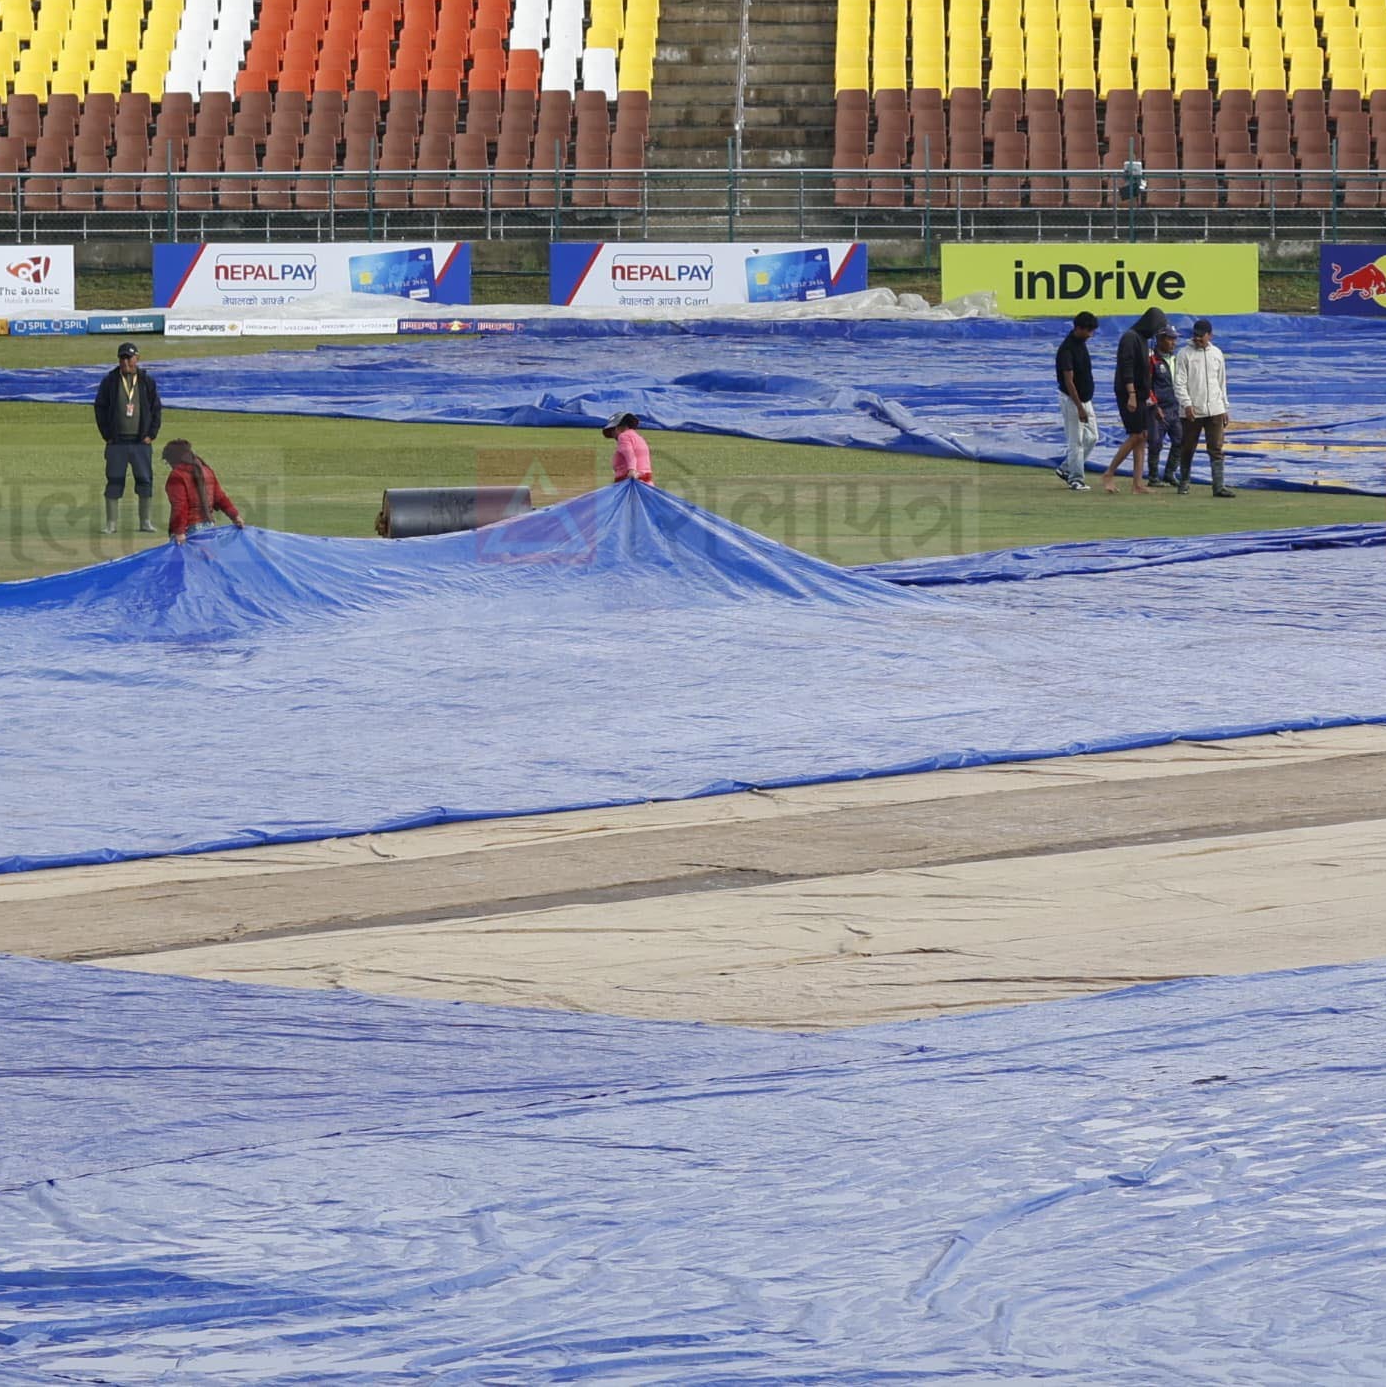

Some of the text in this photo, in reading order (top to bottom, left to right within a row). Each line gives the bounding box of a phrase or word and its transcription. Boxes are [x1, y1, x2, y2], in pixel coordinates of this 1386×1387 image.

[1014, 260, 1186, 300] inDrive
[21, 287, 60, 296] Soaltee
[28, 321, 48, 330] SPIL
[65, 320, 84, 329] SPIL
